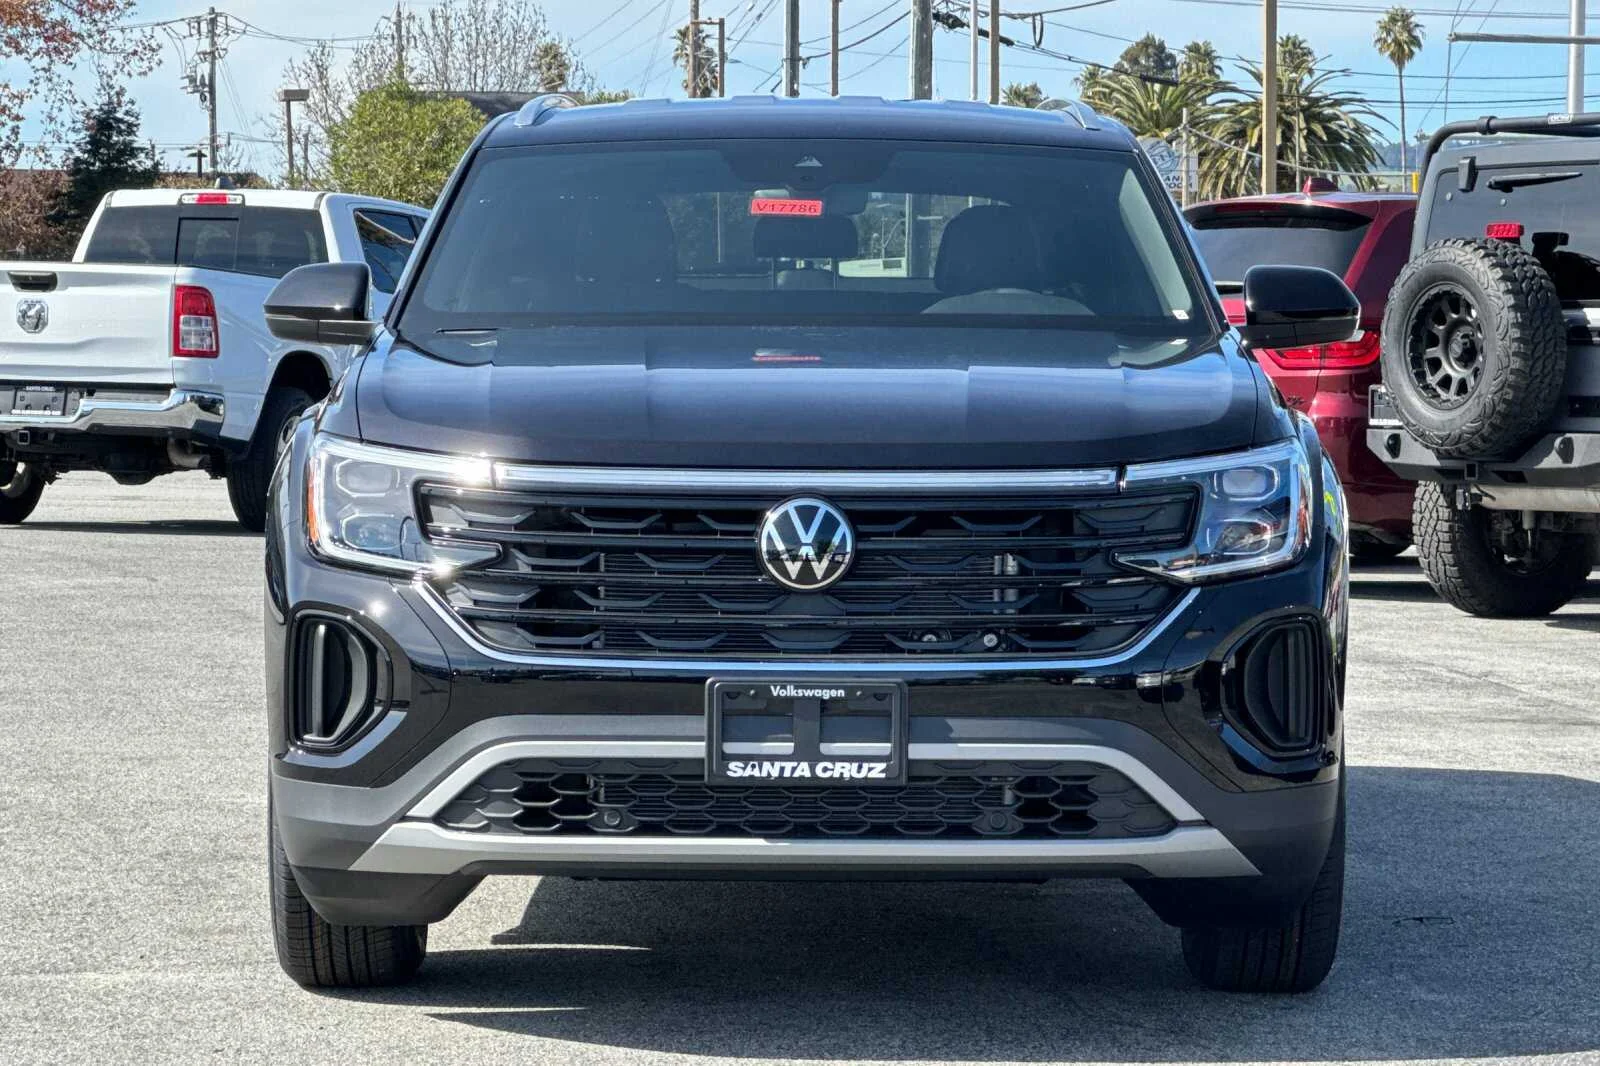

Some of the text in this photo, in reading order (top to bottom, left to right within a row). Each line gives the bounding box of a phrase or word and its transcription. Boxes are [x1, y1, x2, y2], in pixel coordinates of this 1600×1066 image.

[756, 202, 818, 214] V17786
[769, 685, 845, 699] Volkswagen
[726, 761, 887, 778] SANTA CRUZ
